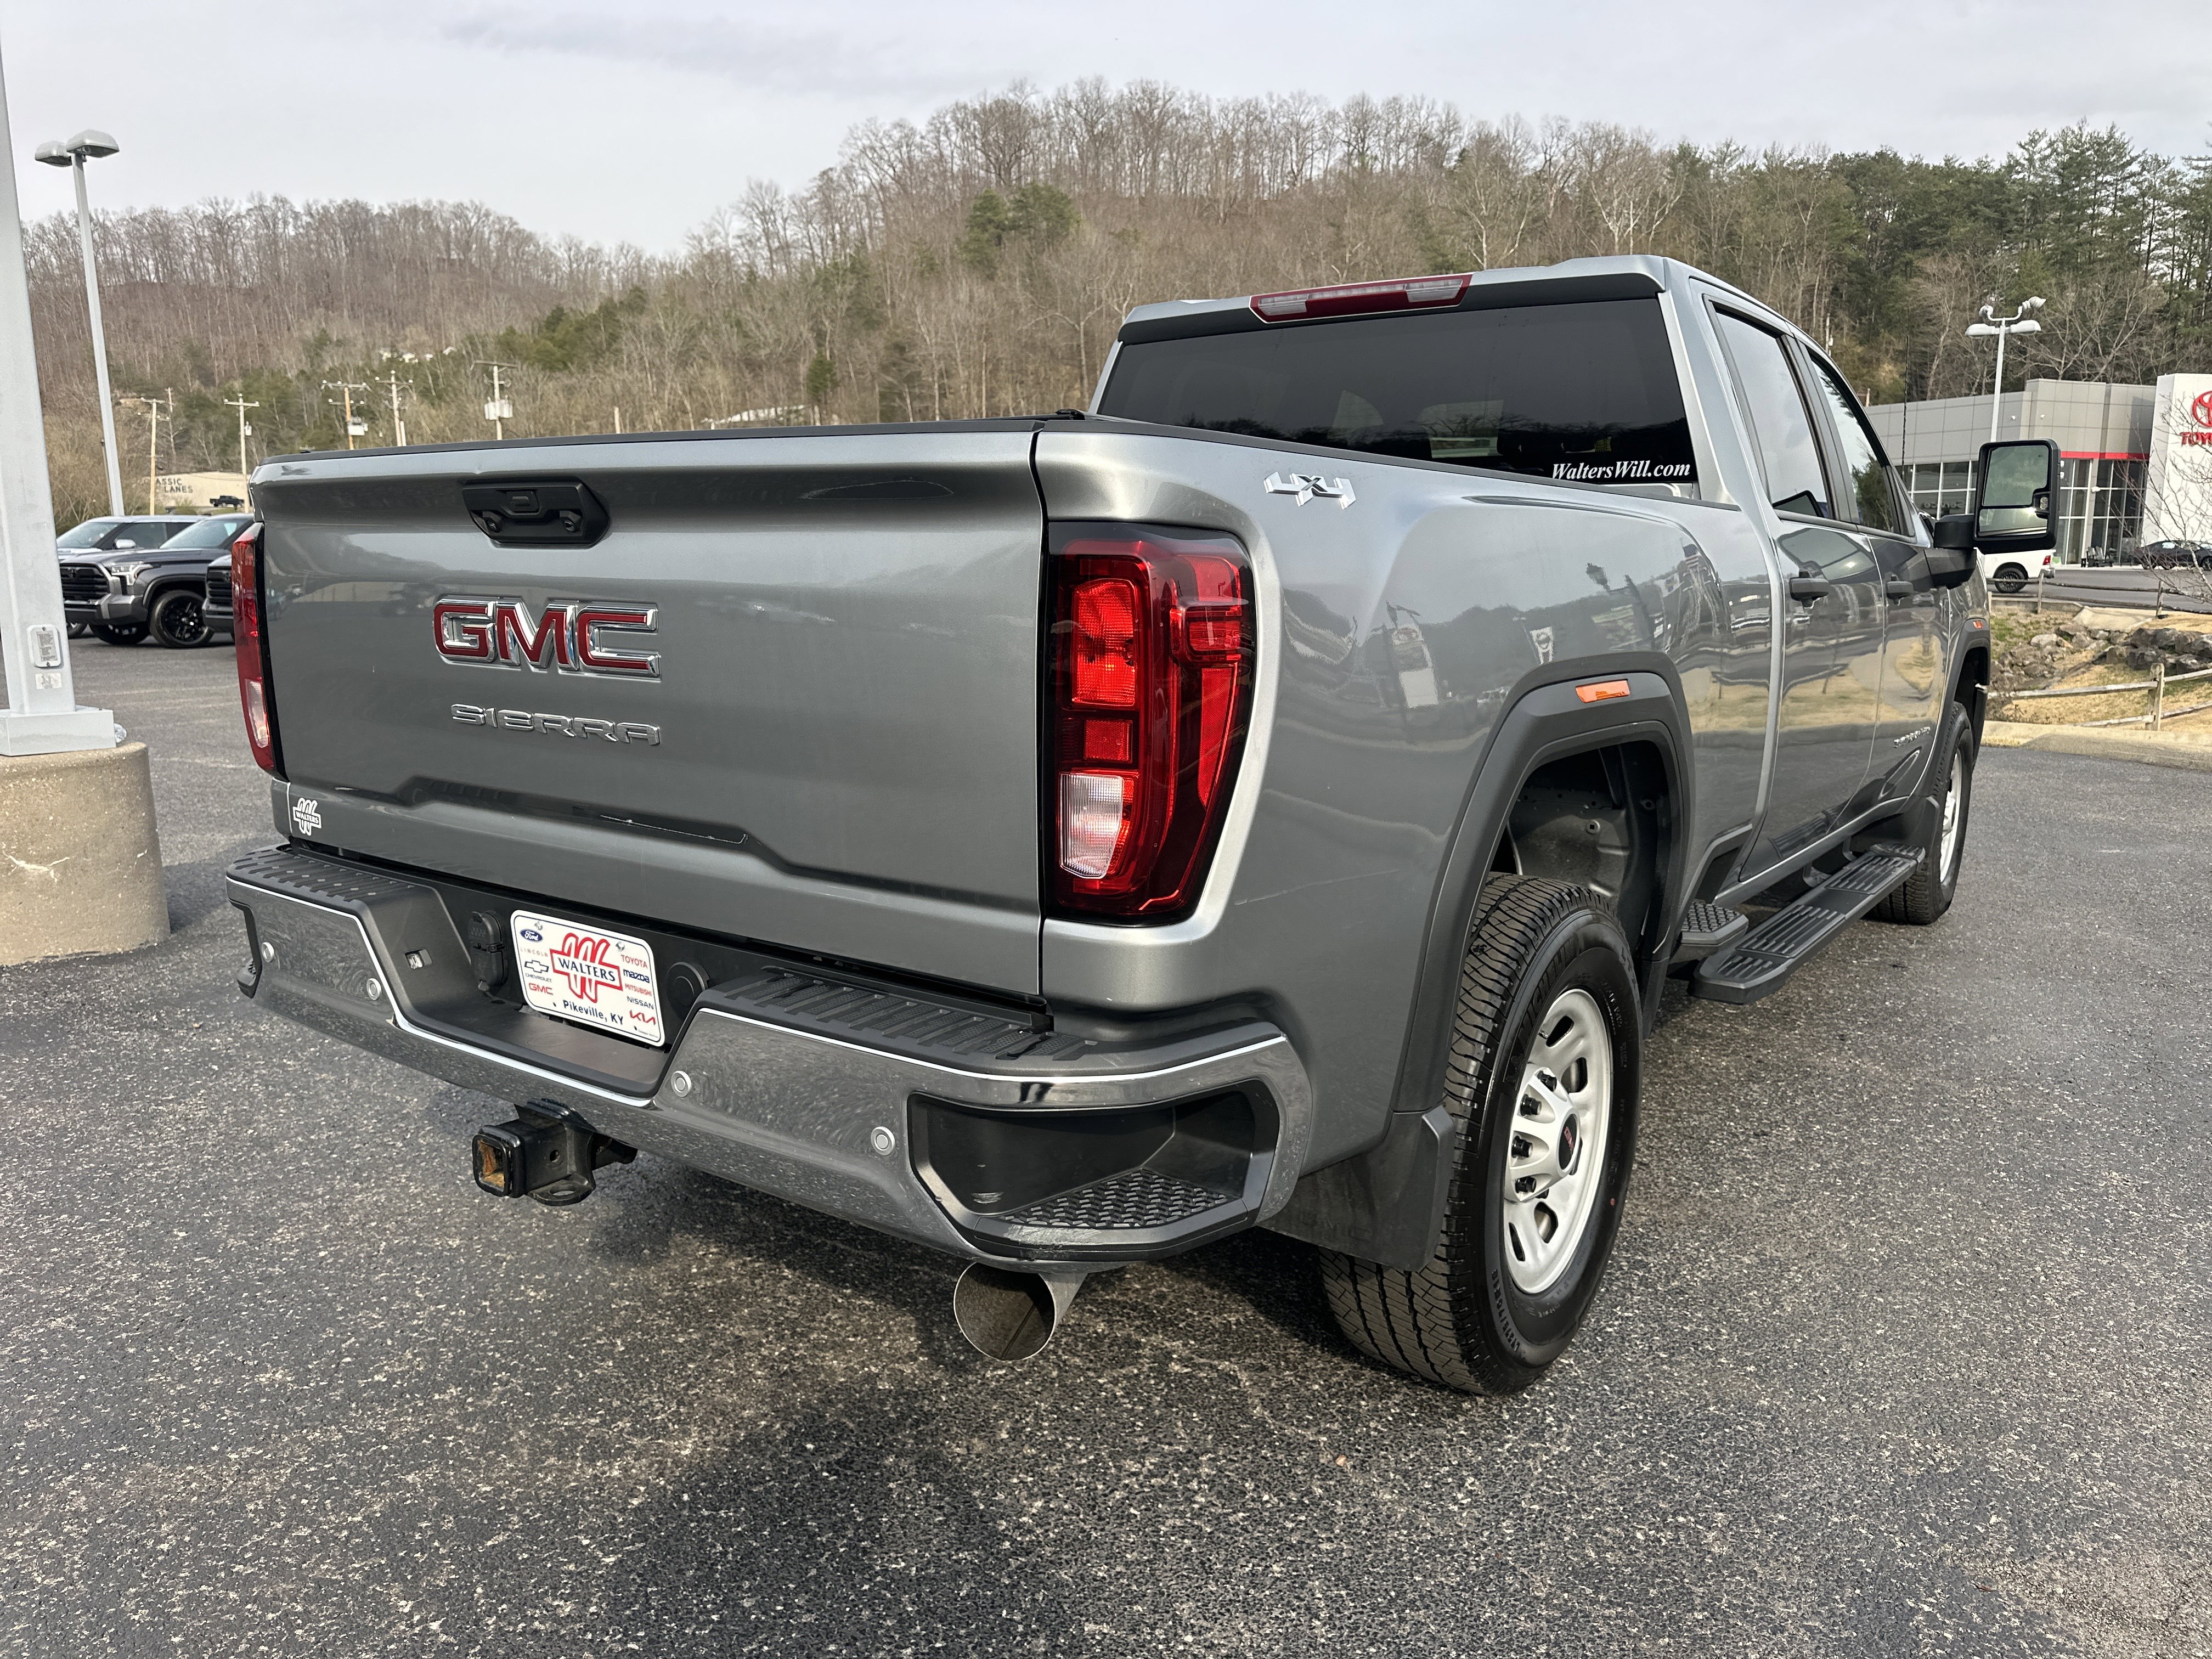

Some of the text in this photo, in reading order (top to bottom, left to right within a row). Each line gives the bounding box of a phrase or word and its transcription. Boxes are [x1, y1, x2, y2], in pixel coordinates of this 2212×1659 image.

[1552, 460, 1690, 479] WaltersWill.com
[164, 485, 193, 493] LANES
[433, 599, 660, 678] GMC
[451, 703, 660, 746] SIERRA
[296, 811, 319, 823] WALTERS
[524, 930, 539, 941] Ford
[520, 947, 548, 957] LINCOLN
[621, 954, 648, 969] TOYOTA
[558, 957, 616, 981] WALTERS
[525, 973, 551, 983] CHEVROLET
[528, 983, 554, 995] GMC
[625, 983, 652, 996] MITSUBISHI
[627, 996, 654, 1009] NISSAN
[563, 999, 623, 1025] Pikeville, KY
[629, 1010, 656, 1025] KIA
